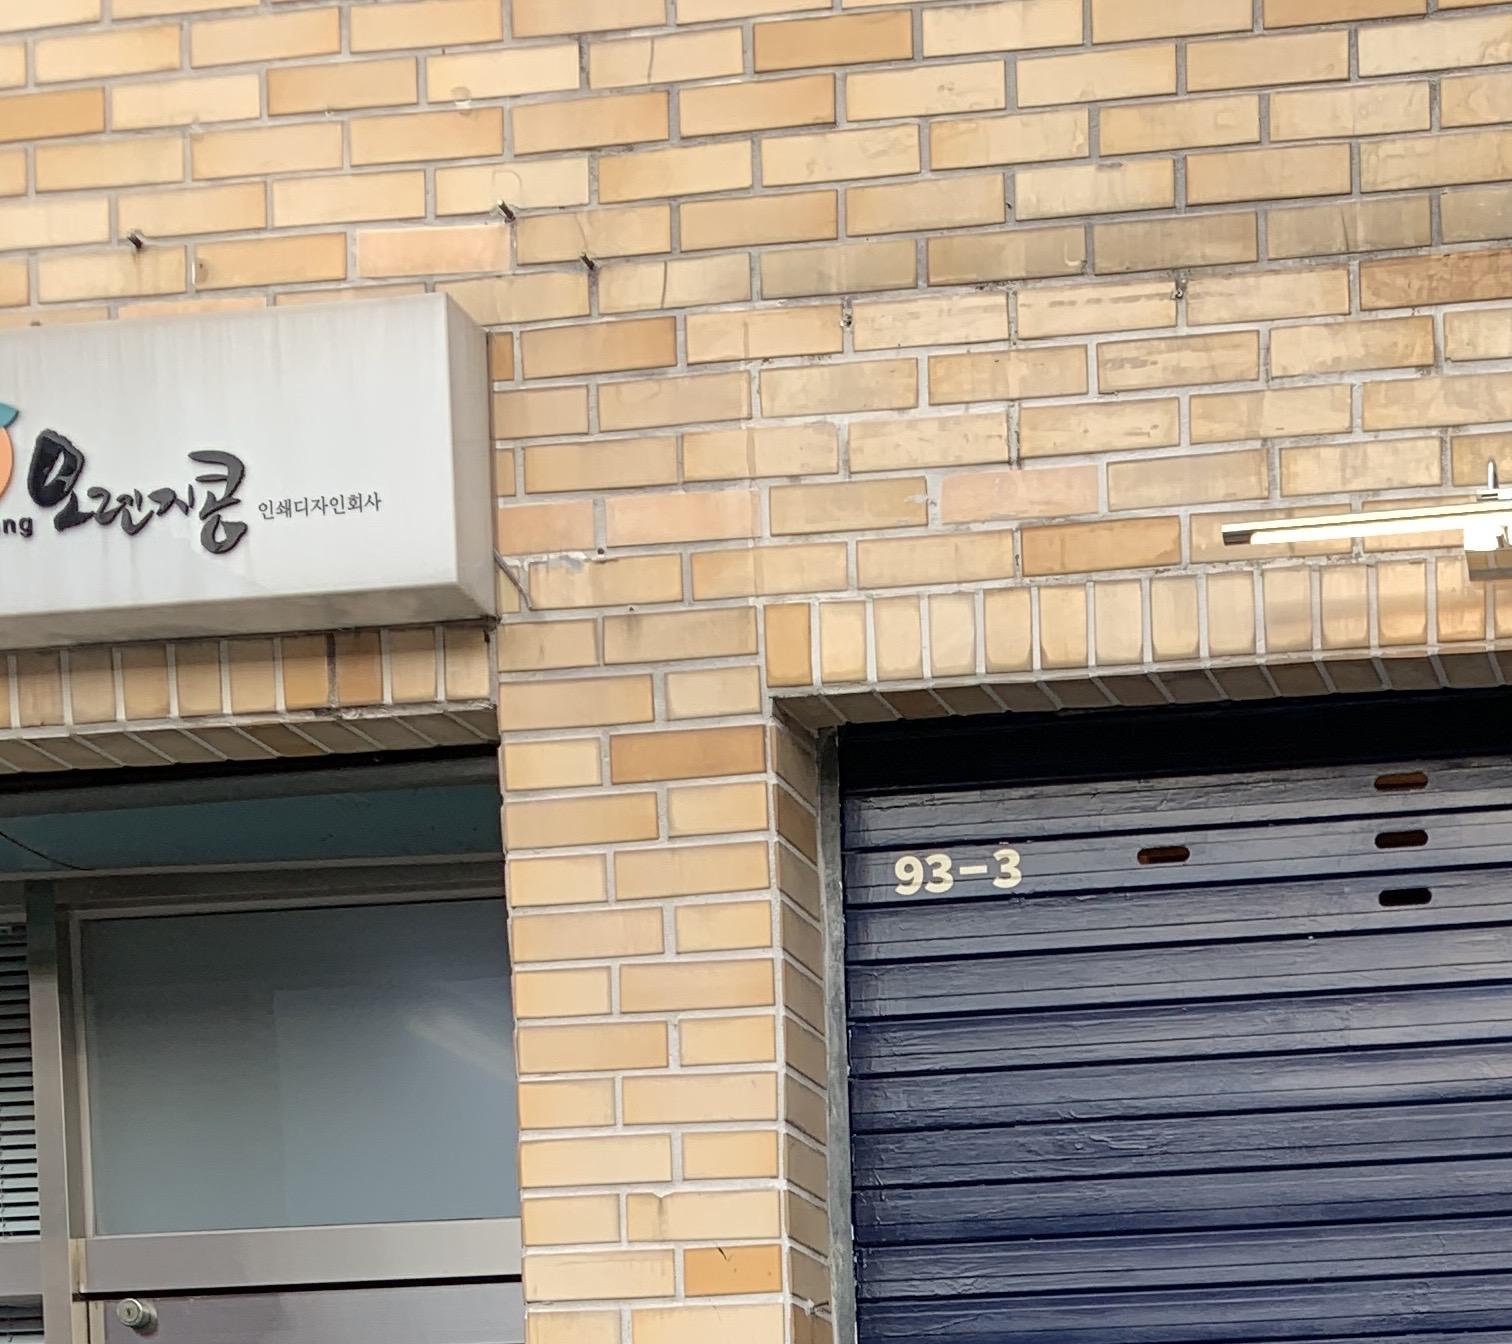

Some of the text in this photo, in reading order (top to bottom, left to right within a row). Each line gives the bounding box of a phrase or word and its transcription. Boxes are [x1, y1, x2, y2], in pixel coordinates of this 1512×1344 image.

[27, 428, 383, 554] 오렌지콩 인쇄디자인회사
[894, 848, 1023, 896] 93-3
